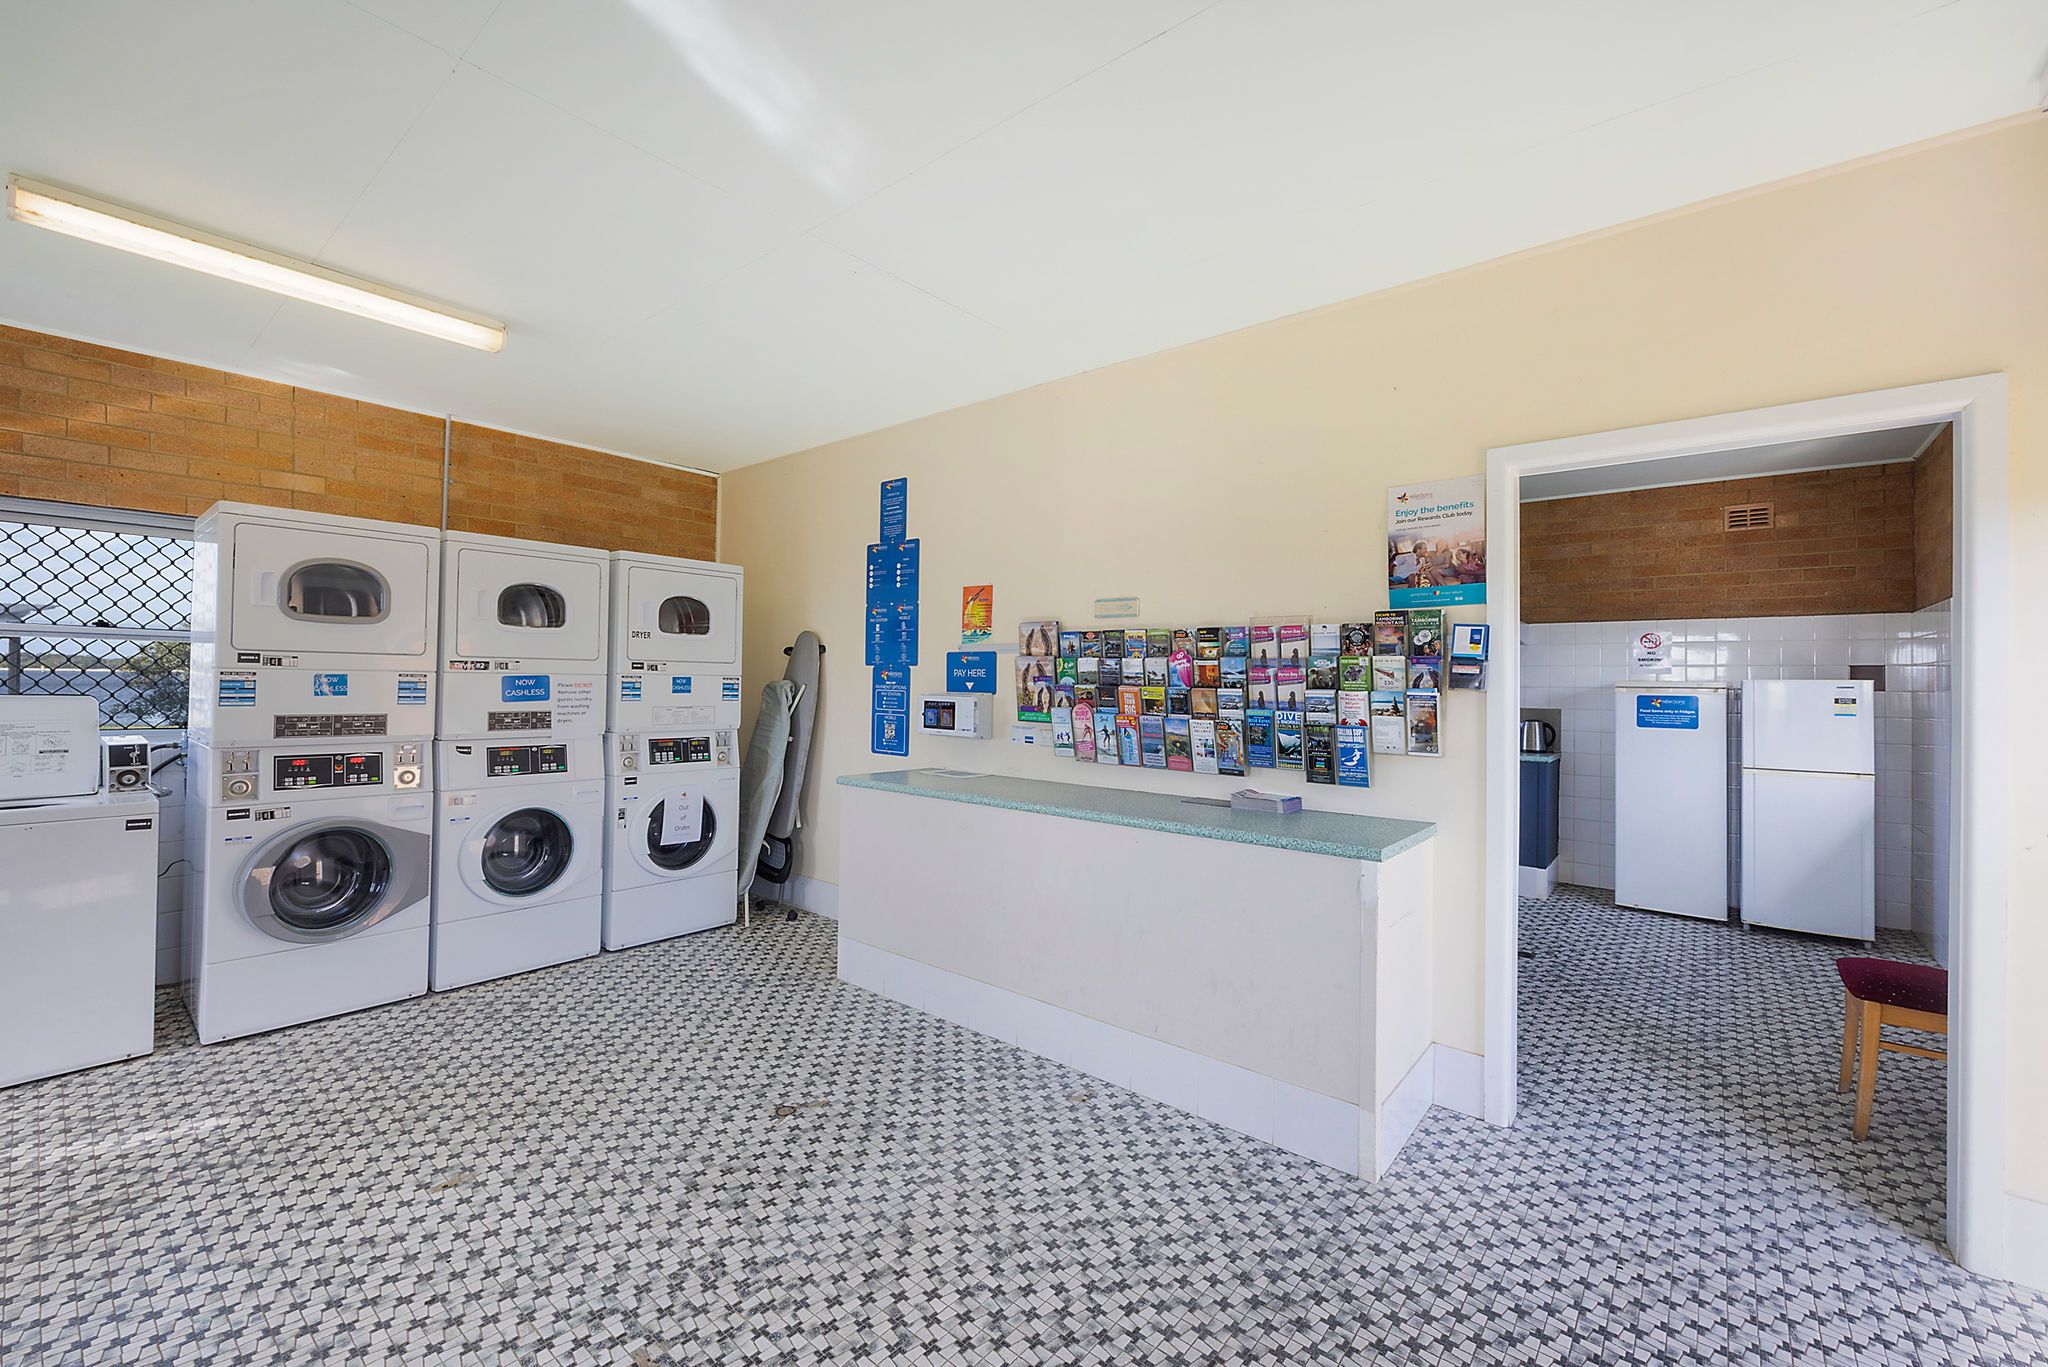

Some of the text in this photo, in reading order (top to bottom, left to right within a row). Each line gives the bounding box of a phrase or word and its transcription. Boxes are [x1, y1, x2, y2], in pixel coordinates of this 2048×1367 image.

[1395, 501, 1475, 518] Enjoy the benefits
[1418, 514, 1441, 522] Rewards
[631, 630, 651, 639] DRYER
[953, 669, 986, 677] PAY HERE
[505, 688, 545, 697] CASHLESS
[1277, 712, 1301, 721] DIVE
